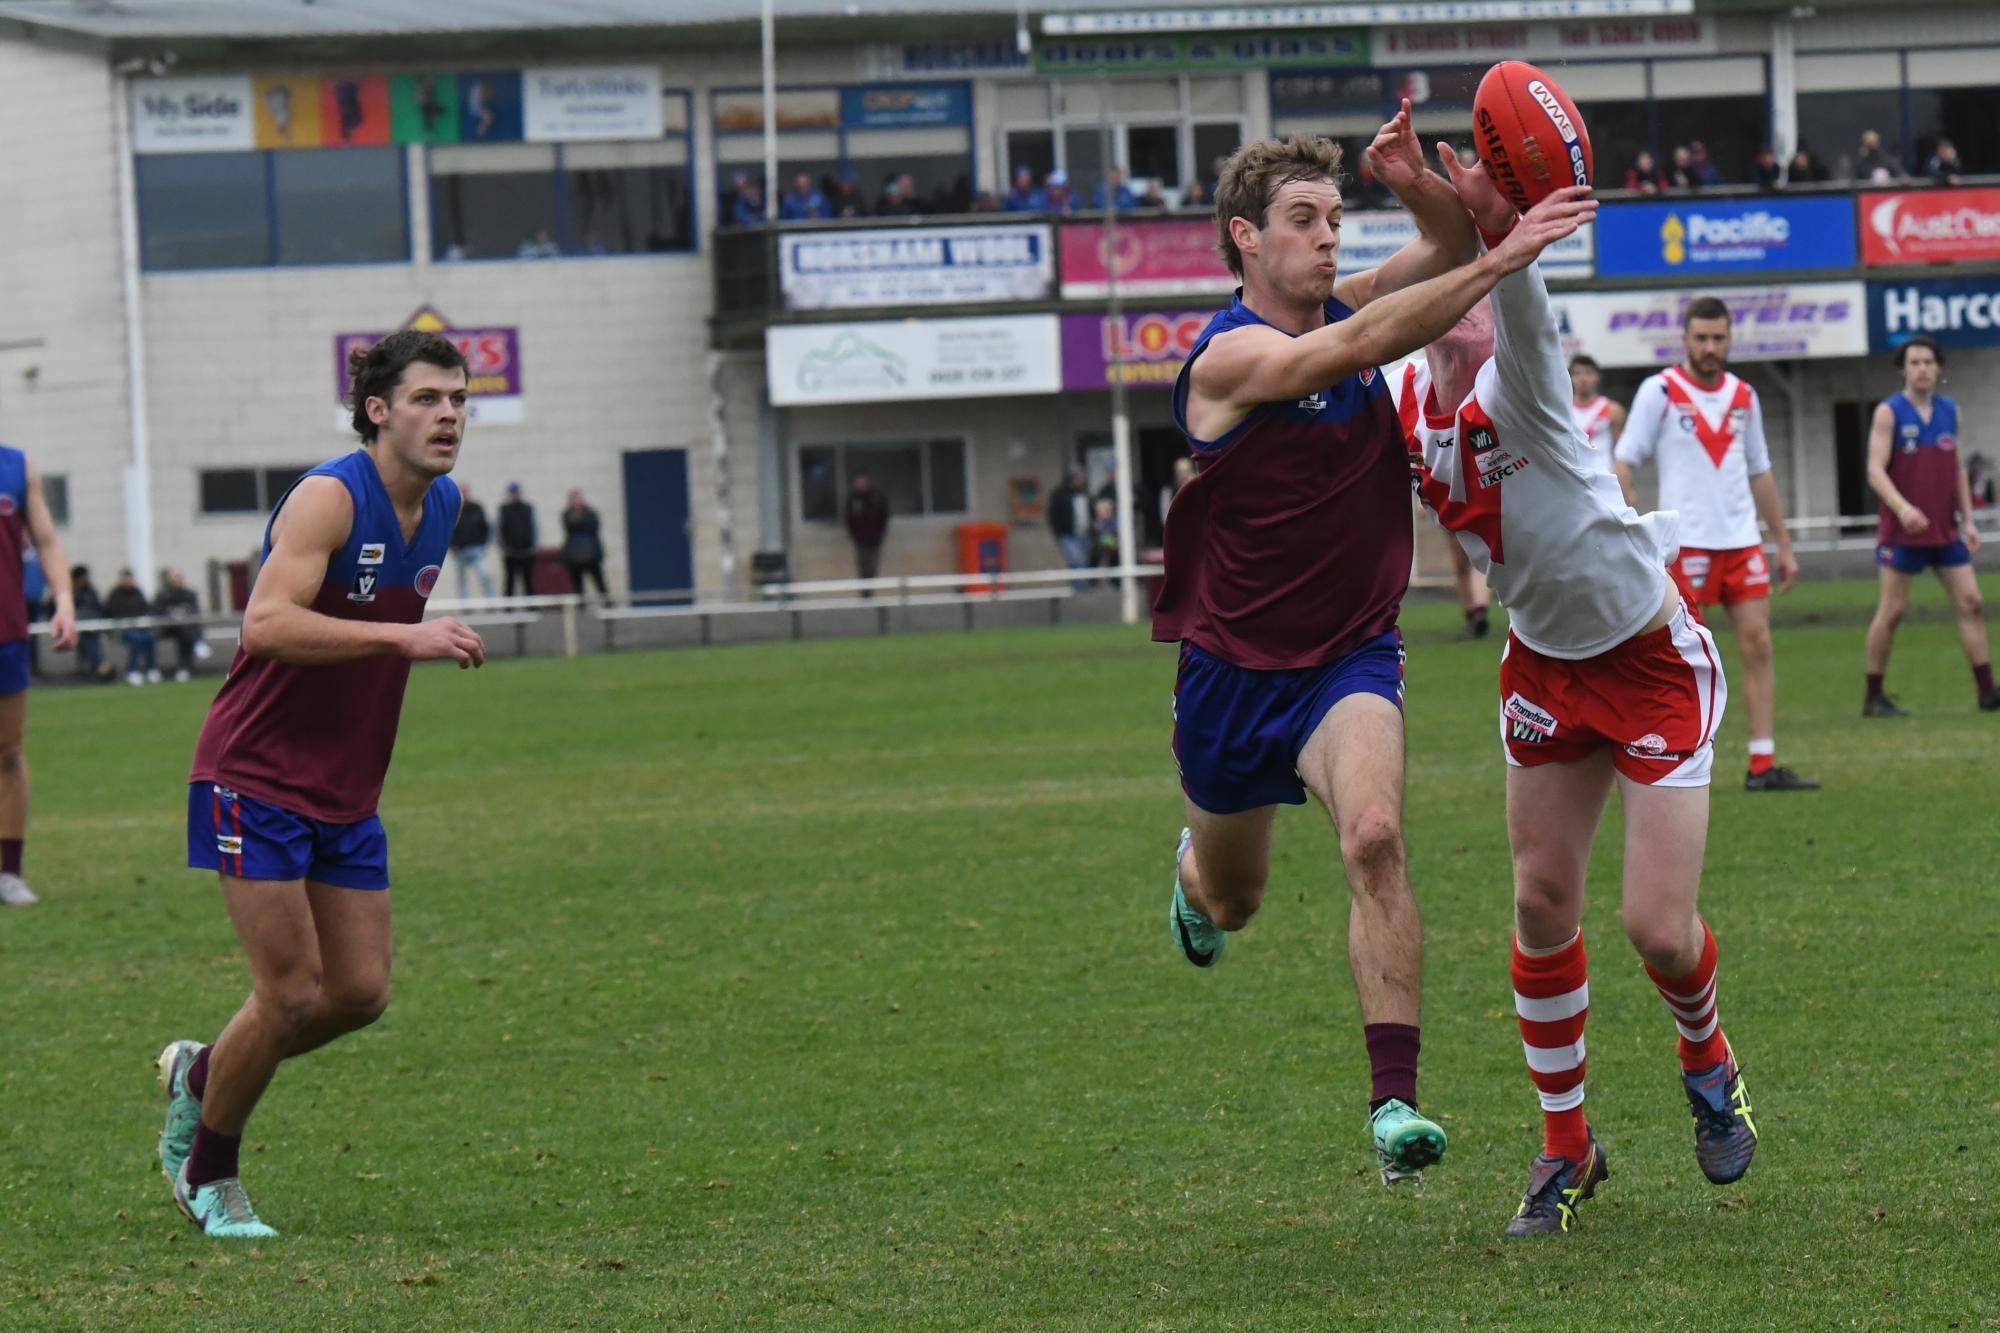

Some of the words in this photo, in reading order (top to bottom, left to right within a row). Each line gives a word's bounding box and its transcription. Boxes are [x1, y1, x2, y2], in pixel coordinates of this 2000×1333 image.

[184, 91, 239, 118] Side
[1687, 210, 1790, 245] Pacific
[1488, 465, 1514, 485] KFC
[1510, 698, 1555, 728] Promotional
